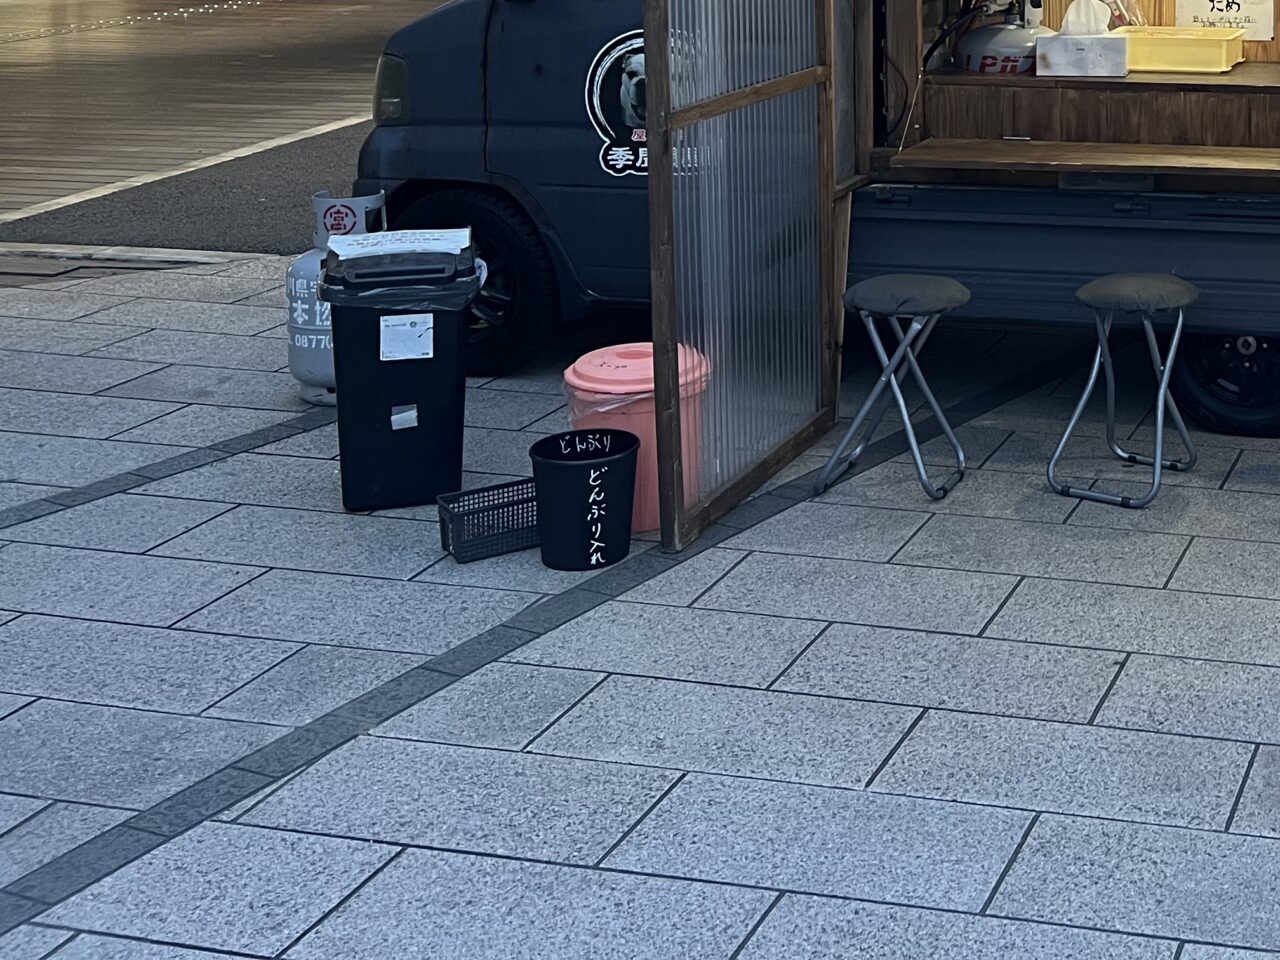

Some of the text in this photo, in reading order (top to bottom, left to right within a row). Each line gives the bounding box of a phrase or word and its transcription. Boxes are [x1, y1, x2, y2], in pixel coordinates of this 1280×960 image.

[559, 434, 612, 454] どんぶり
[587, 466, 608, 565] どんぶり入れ
